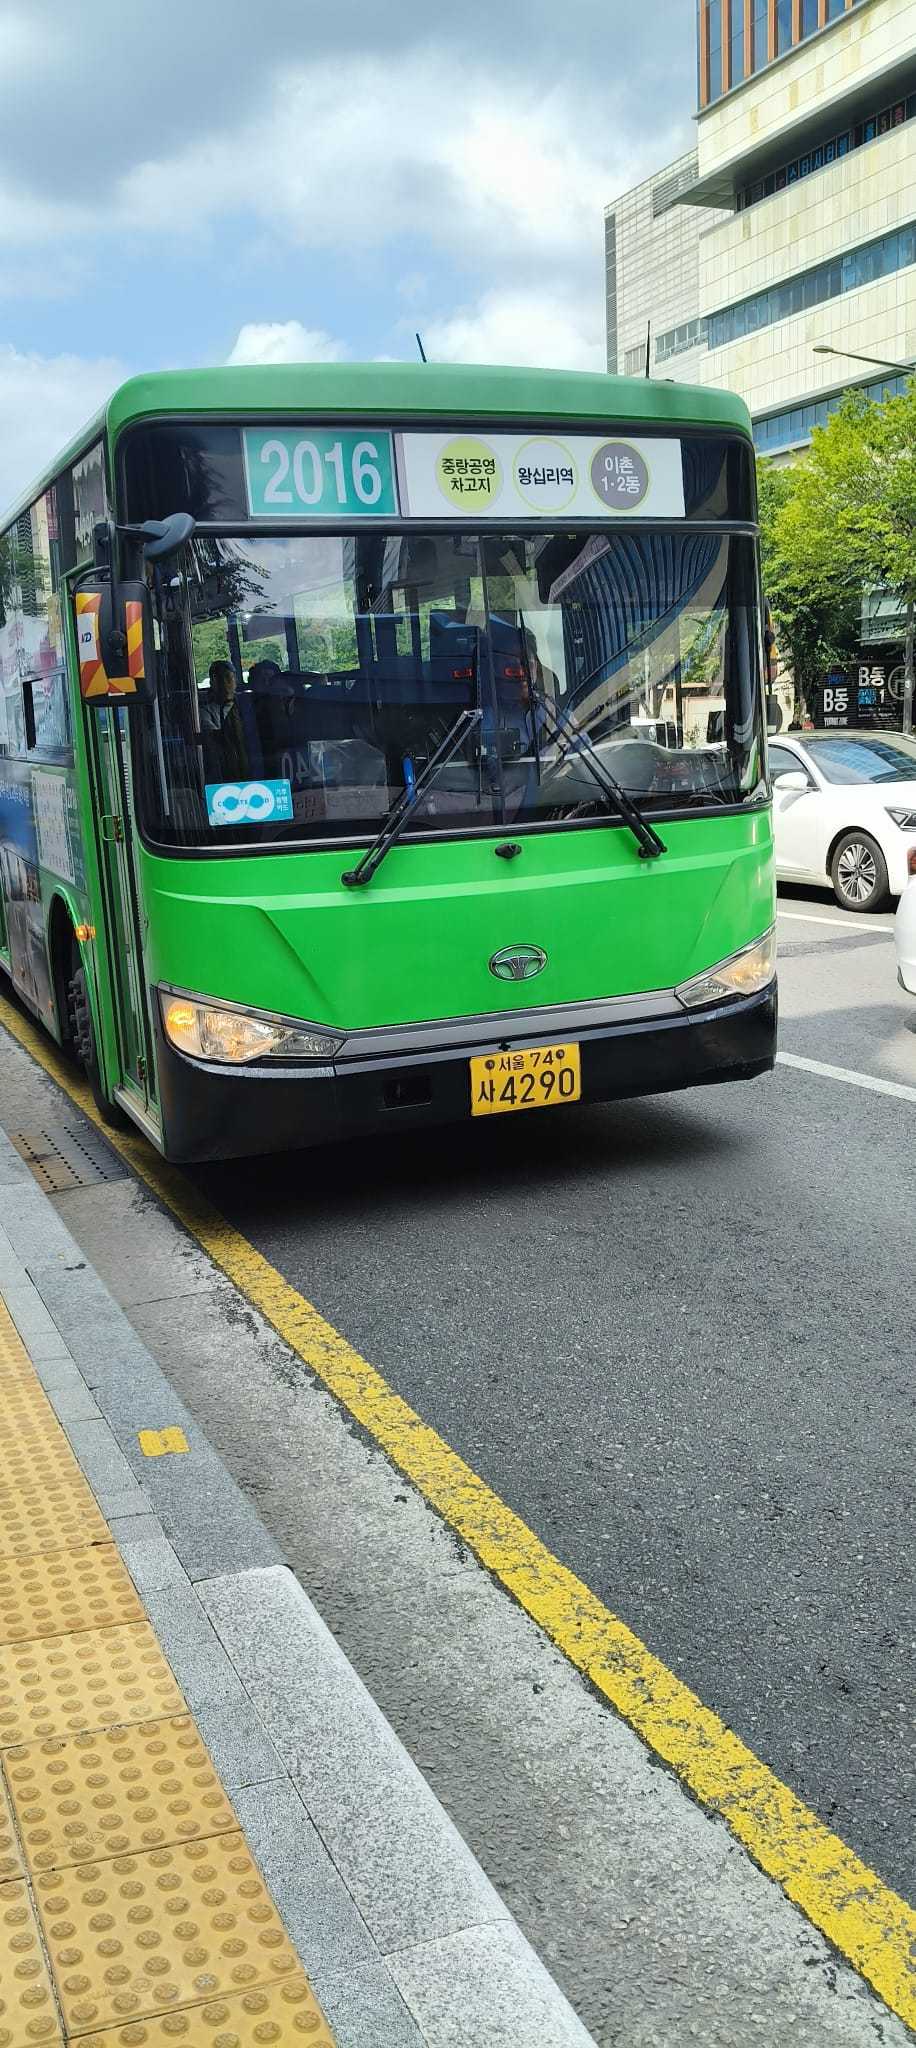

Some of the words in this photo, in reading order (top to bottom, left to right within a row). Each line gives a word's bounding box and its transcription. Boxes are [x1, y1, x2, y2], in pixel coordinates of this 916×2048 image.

[260, 439, 382, 505] 2016
[442, 458, 496, 475] 중랑공영
[604, 456, 635, 474] 이촌
[451, 477, 491, 493] 차고지
[518, 467, 574, 486] 왕십리역
[858, 666, 886, 687] B동
[823, 688, 849, 713] B동
[499, 1055, 525, 1071] 서울
[530, 1050, 554, 1067] 74
